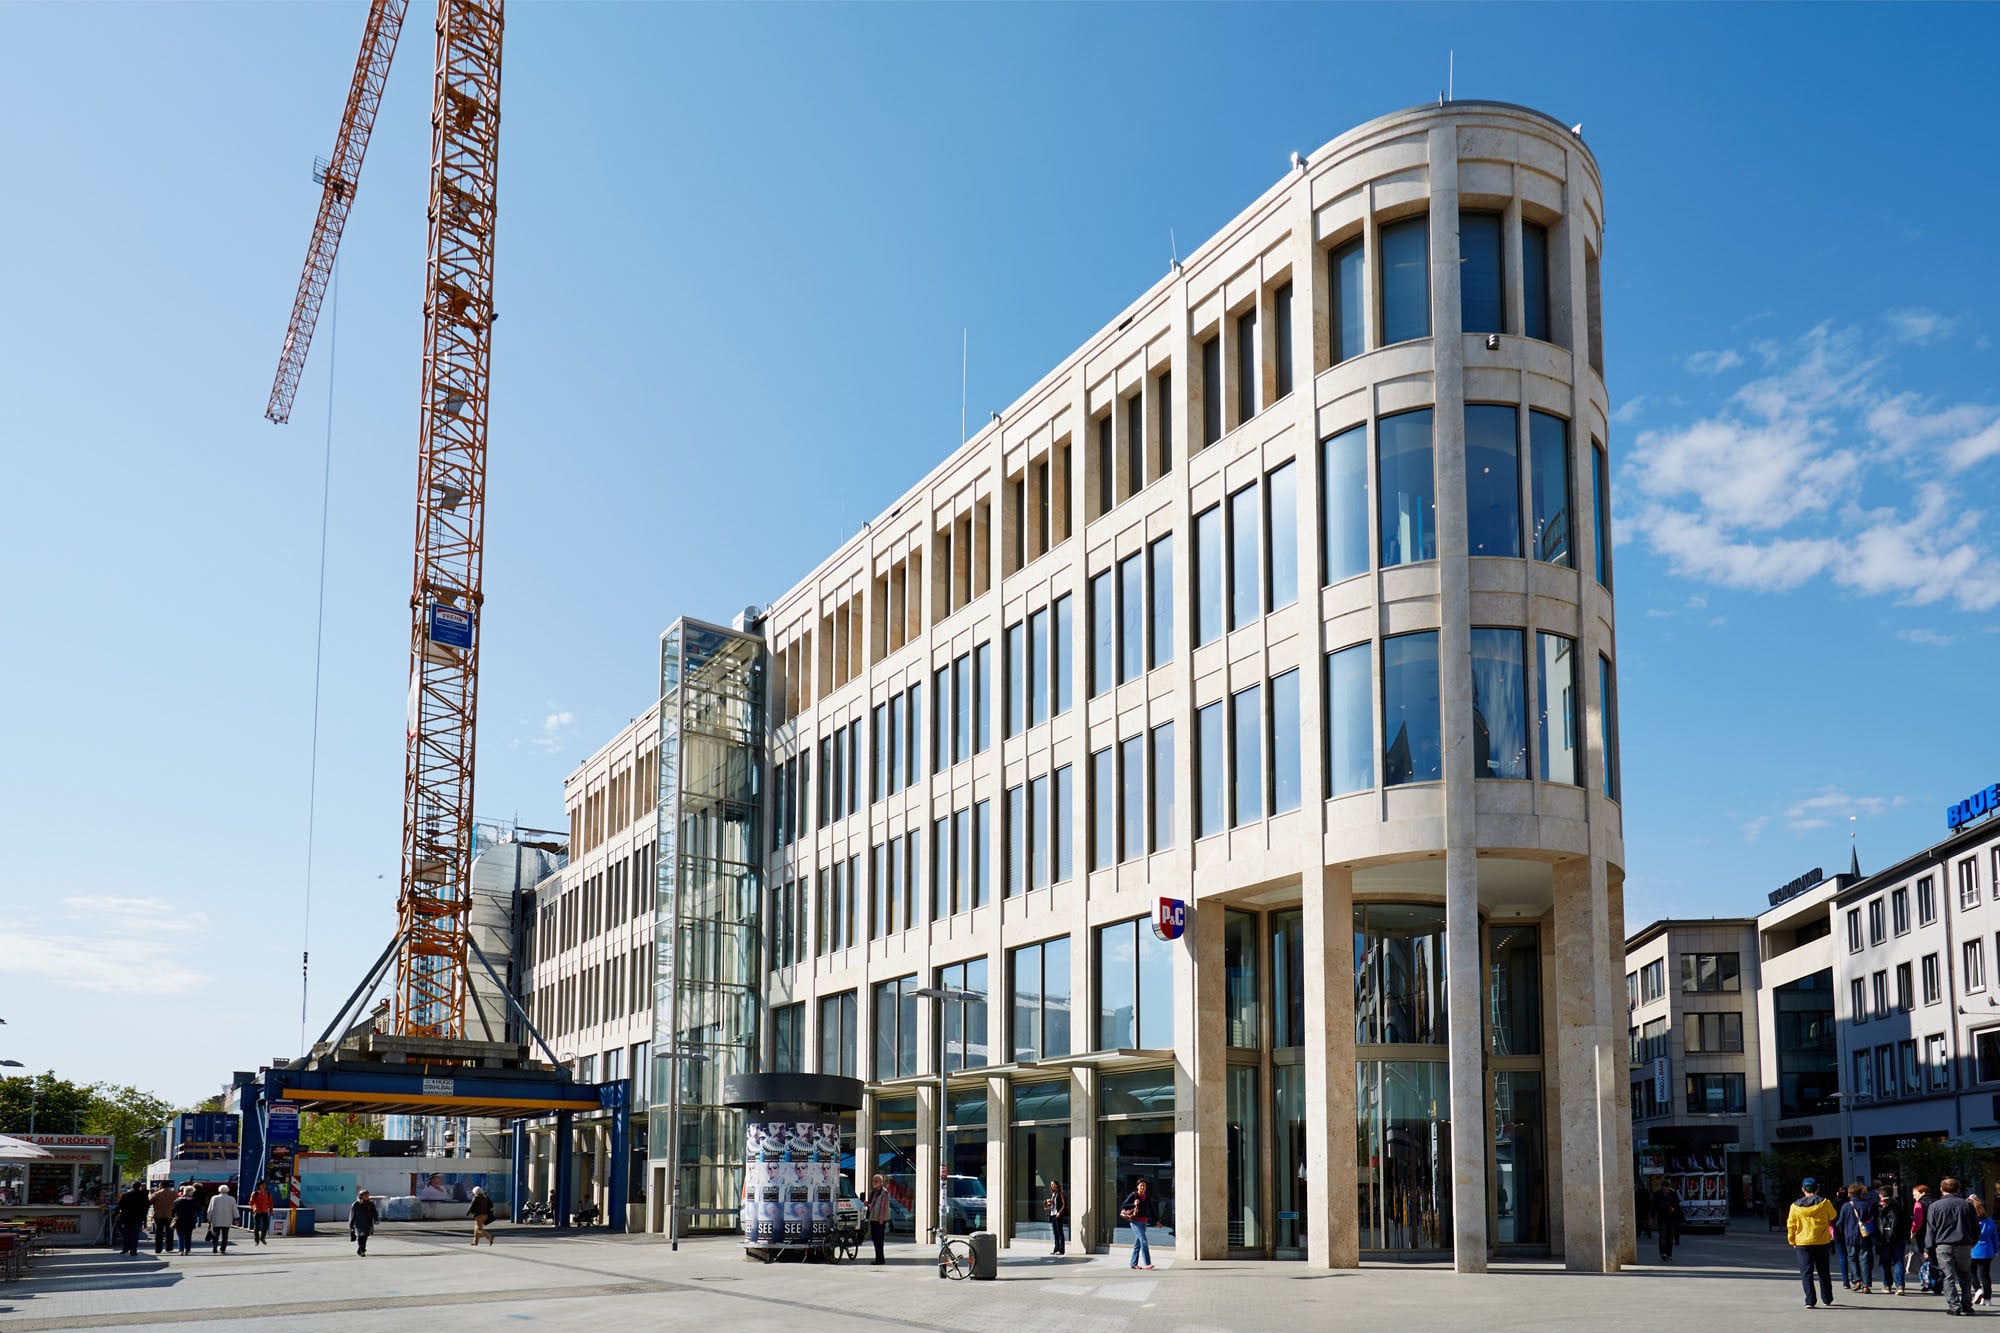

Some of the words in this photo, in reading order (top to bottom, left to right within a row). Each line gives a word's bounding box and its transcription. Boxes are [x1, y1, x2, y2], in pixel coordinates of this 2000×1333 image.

[1947, 783, 2000, 829] BLUE
[1162, 905, 1183, 926] P&C
[57, 1136, 109, 1144] KRÖPCKE
[306, 1184, 338, 1192] EINGANG
[758, 1223, 773, 1234] SEE
[784, 1223, 801, 1234] SEE
[812, 1223, 826, 1234] SEE
